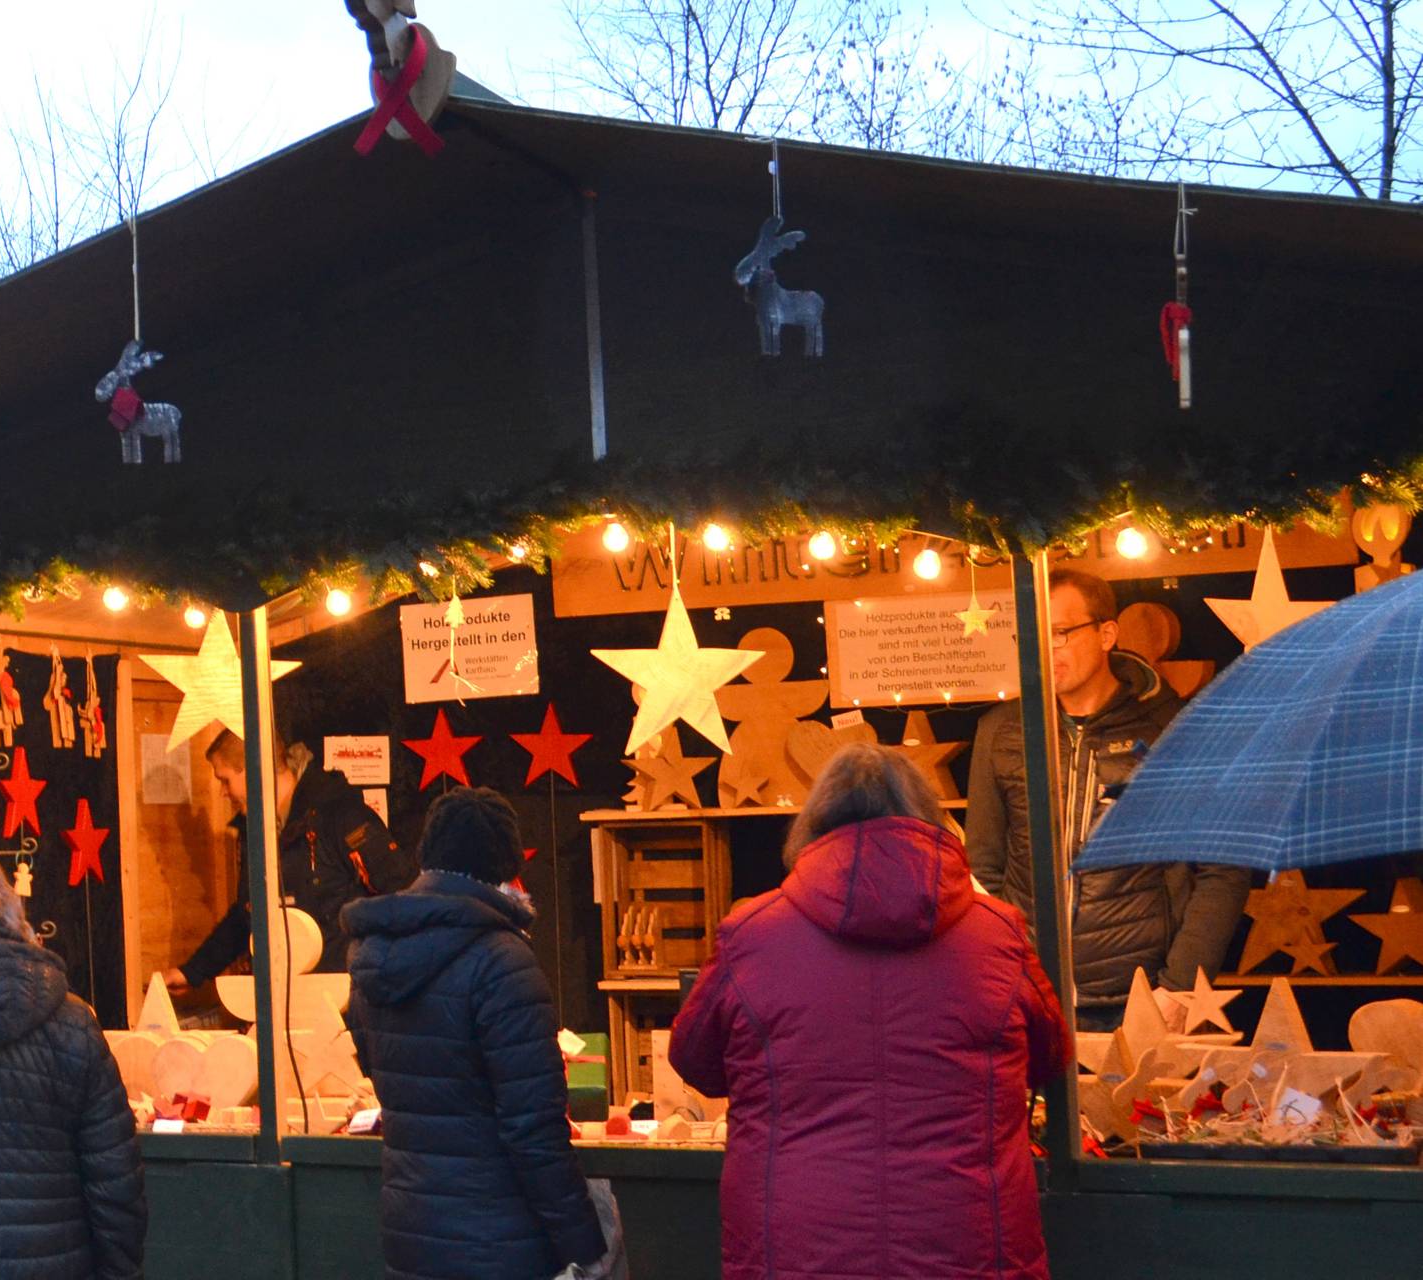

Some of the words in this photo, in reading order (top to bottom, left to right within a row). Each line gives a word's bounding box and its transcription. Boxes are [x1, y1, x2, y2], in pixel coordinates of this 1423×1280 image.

[423, 611, 511, 629] Holodukte
[866, 609, 936, 624] Holzprodukte
[485, 631, 497, 645] in
[501, 630, 526, 643] den
[839, 628, 857, 639] Die
[859, 627, 879, 638] hier
[882, 623, 938, 636] verkauften
[878, 639, 900, 650] sind
[903, 639, 918, 649] mit
[921, 636, 941, 647] viel
[943, 634, 973, 646] Liebe
[867, 655, 887, 665] von
[890, 653, 910, 664] den
[849, 670, 859, 680] in
[861, 669, 878, 680] der
[877, 679, 933, 693] hergestellt
